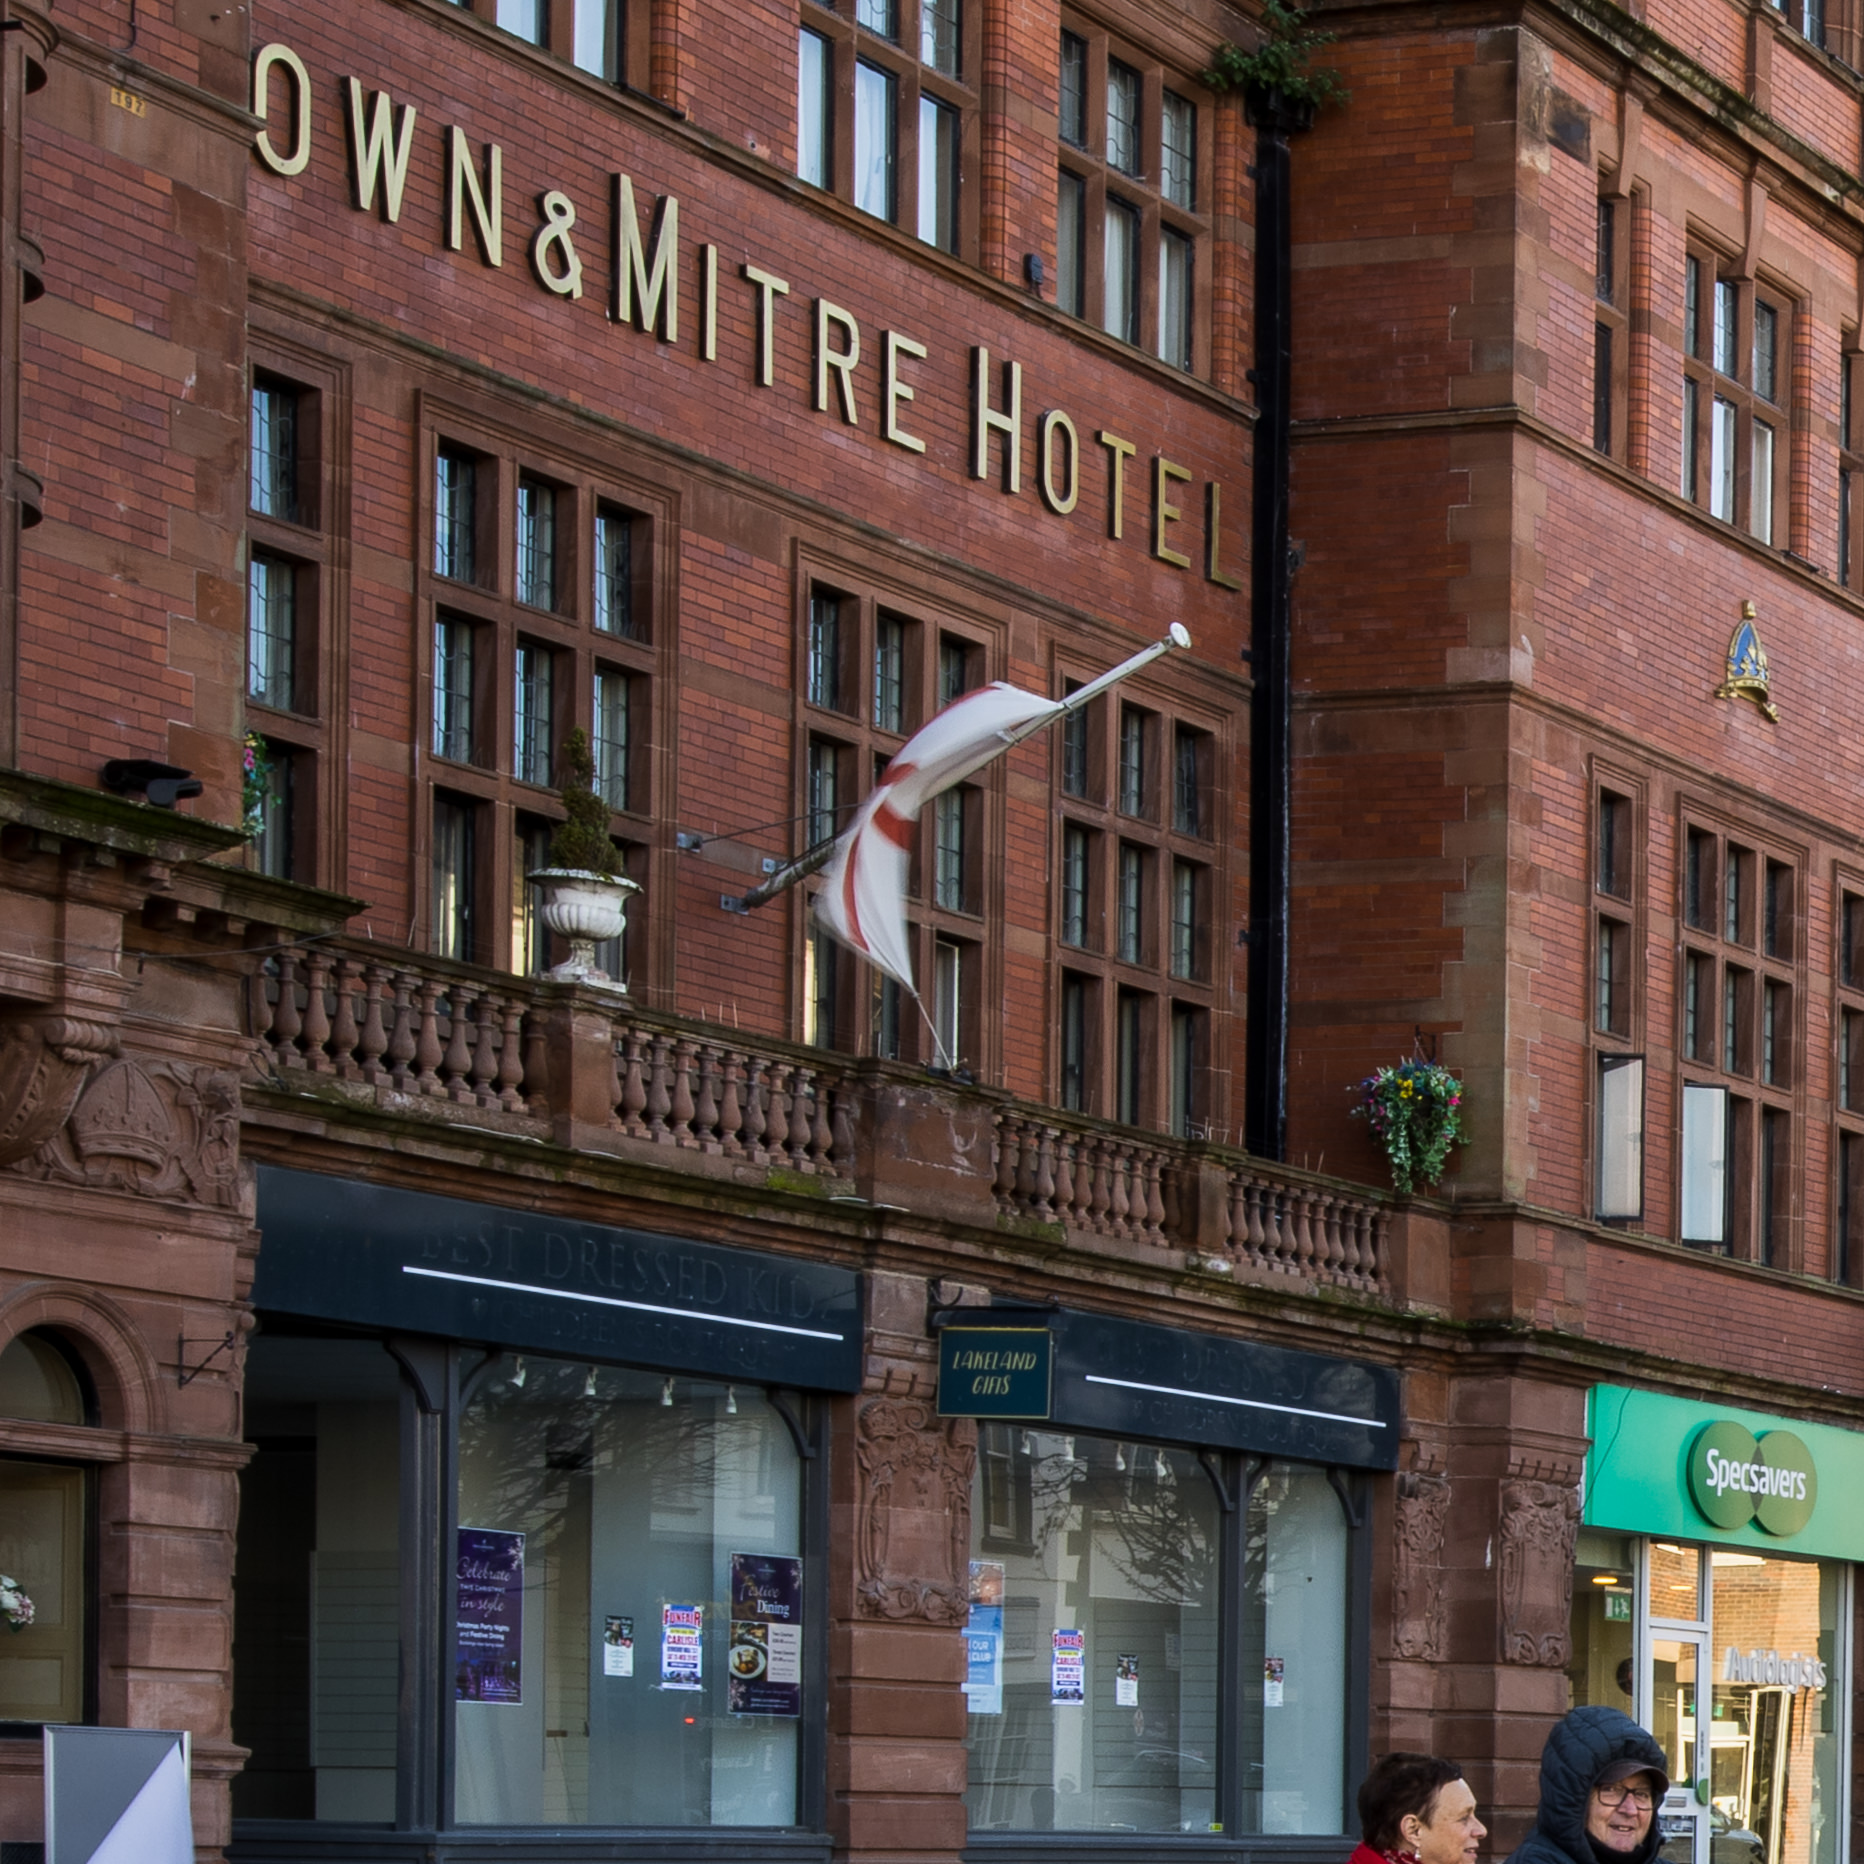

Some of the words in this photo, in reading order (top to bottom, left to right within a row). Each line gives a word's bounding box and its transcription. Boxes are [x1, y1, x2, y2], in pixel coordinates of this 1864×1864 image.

[608, 172, 928, 454] MITRE
[971, 345, 1243, 591] HOTEL
[952, 1350, 1038, 1370] LAKELAND
[971, 1374, 1012, 1395] GIFTS
[1705, 1448, 1807, 1501] Specsavers
[456, 1556, 512, 1582] Celebrate
[740, 1573, 780, 1602] Festive
[477, 1593, 505, 1618] style
[757, 1599, 790, 1619] Dining
[663, 1608, 702, 1628] FUNFAIR
[667, 1634, 699, 1647] CARLISLE
[971, 1640, 989, 1651] OUR
[1723, 1646, 1828, 1695] Audiologists
